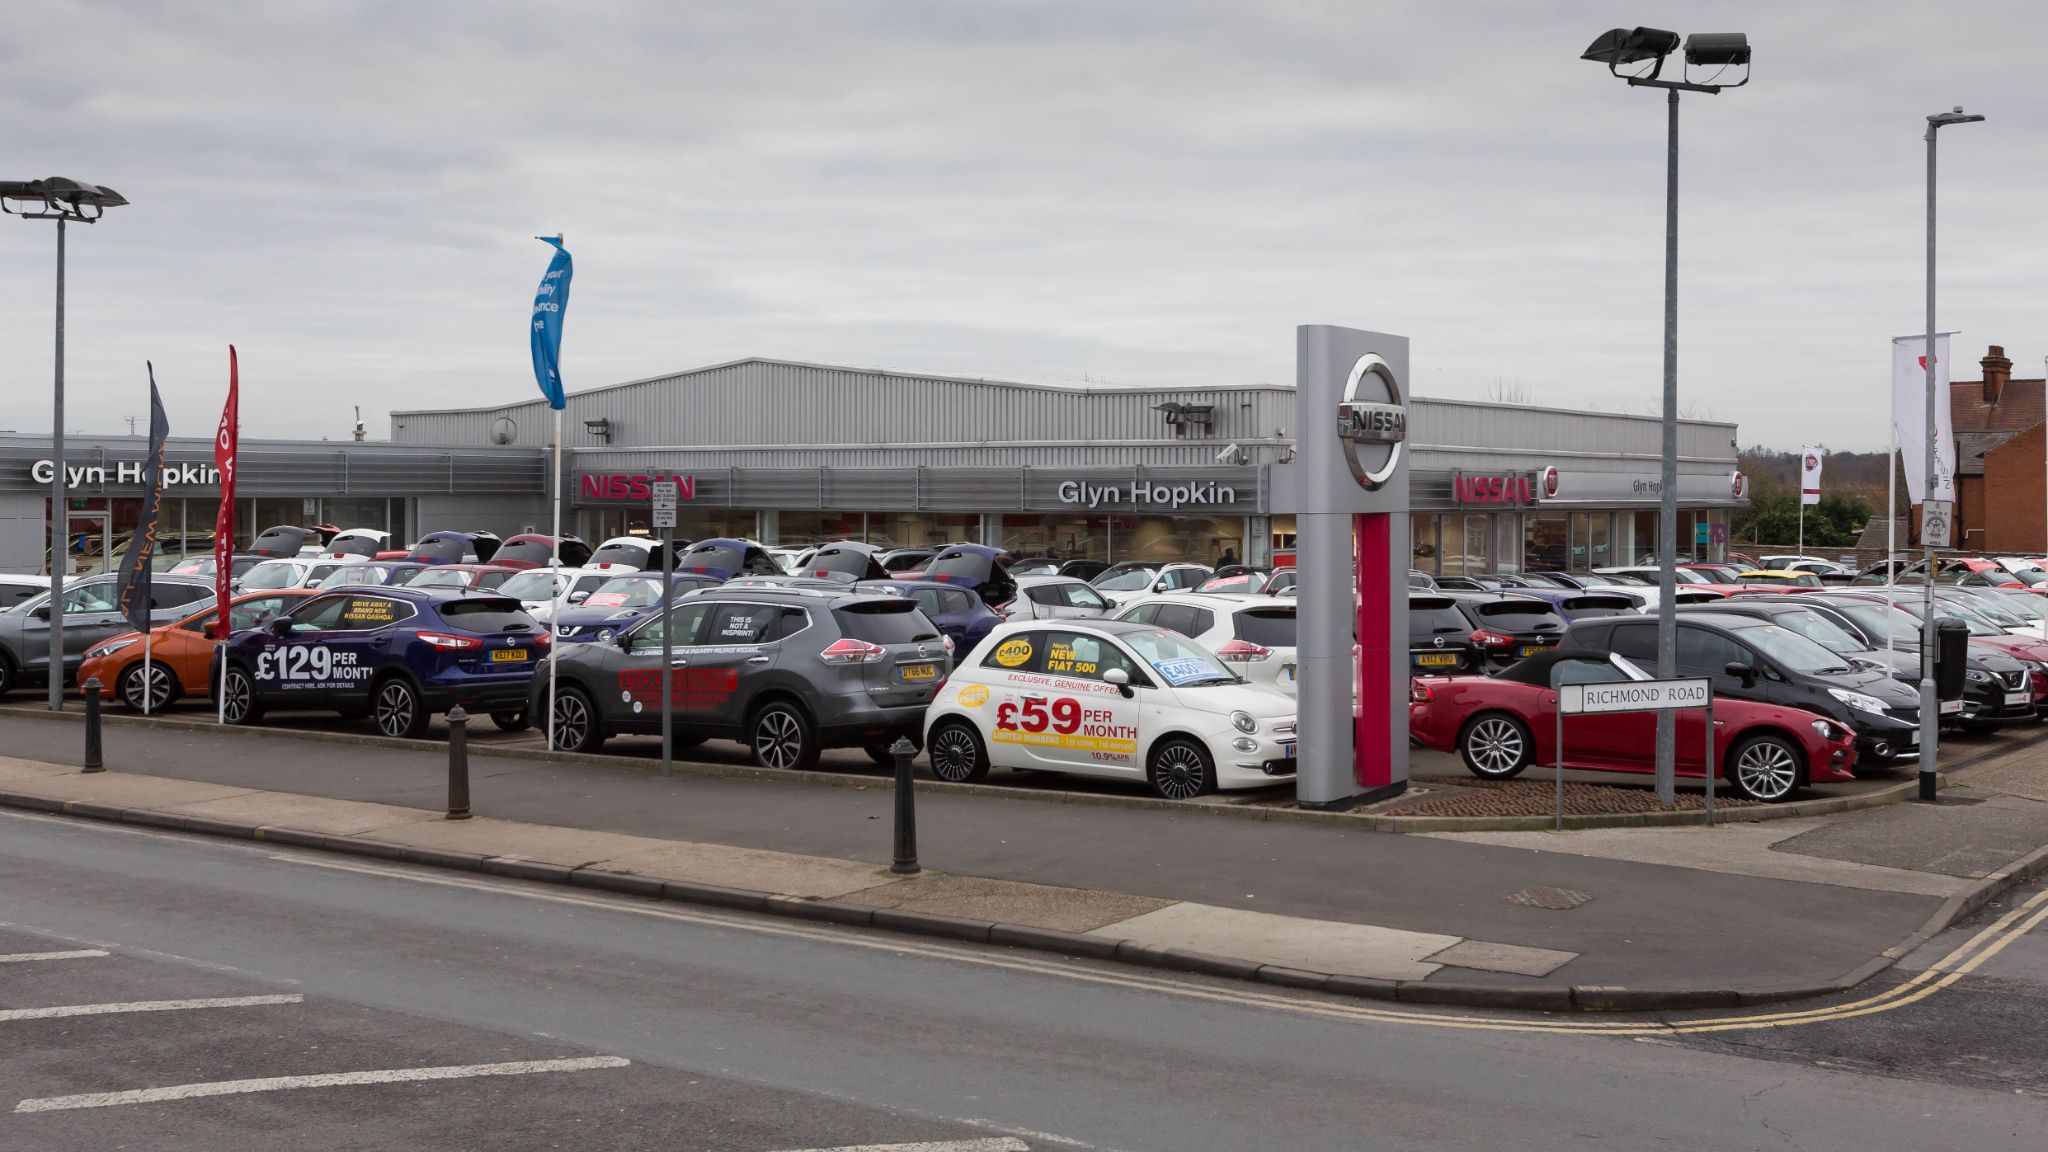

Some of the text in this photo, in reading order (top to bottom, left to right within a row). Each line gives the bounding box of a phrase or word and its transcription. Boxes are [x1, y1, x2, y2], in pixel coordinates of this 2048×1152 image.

[1352, 410, 1406, 432] NISSAN
[117, 461, 222, 489] Hpkin
[1455, 475, 1531, 504] NISSAN
[1633, 479, 1647, 494] Glyn
[1058, 481, 1235, 508] Glyn Hopkin
[721, 629, 753, 637] MISPRINT!
[1052, 642, 1070, 650] Nearly
[333, 652, 357, 665] PER
[494, 650, 510, 659] KE17
[1050, 649, 1077, 660] NEW
[254, 645, 332, 681] £129
[1047, 660, 1096, 674] FIAT 500
[333, 667, 373, 680] MONT
[1007, 673, 1052, 686] EXCLUSIVE,
[1053, 679, 1092, 692] GENUINE
[1587, 686, 1705, 705] RICHMOND ROAD
[996, 697, 1082, 735] £59
[1083, 710, 1113, 723] PER
[1083, 724, 1138, 739] MONTH
[1090, 751, 1117, 761] 10.9%
